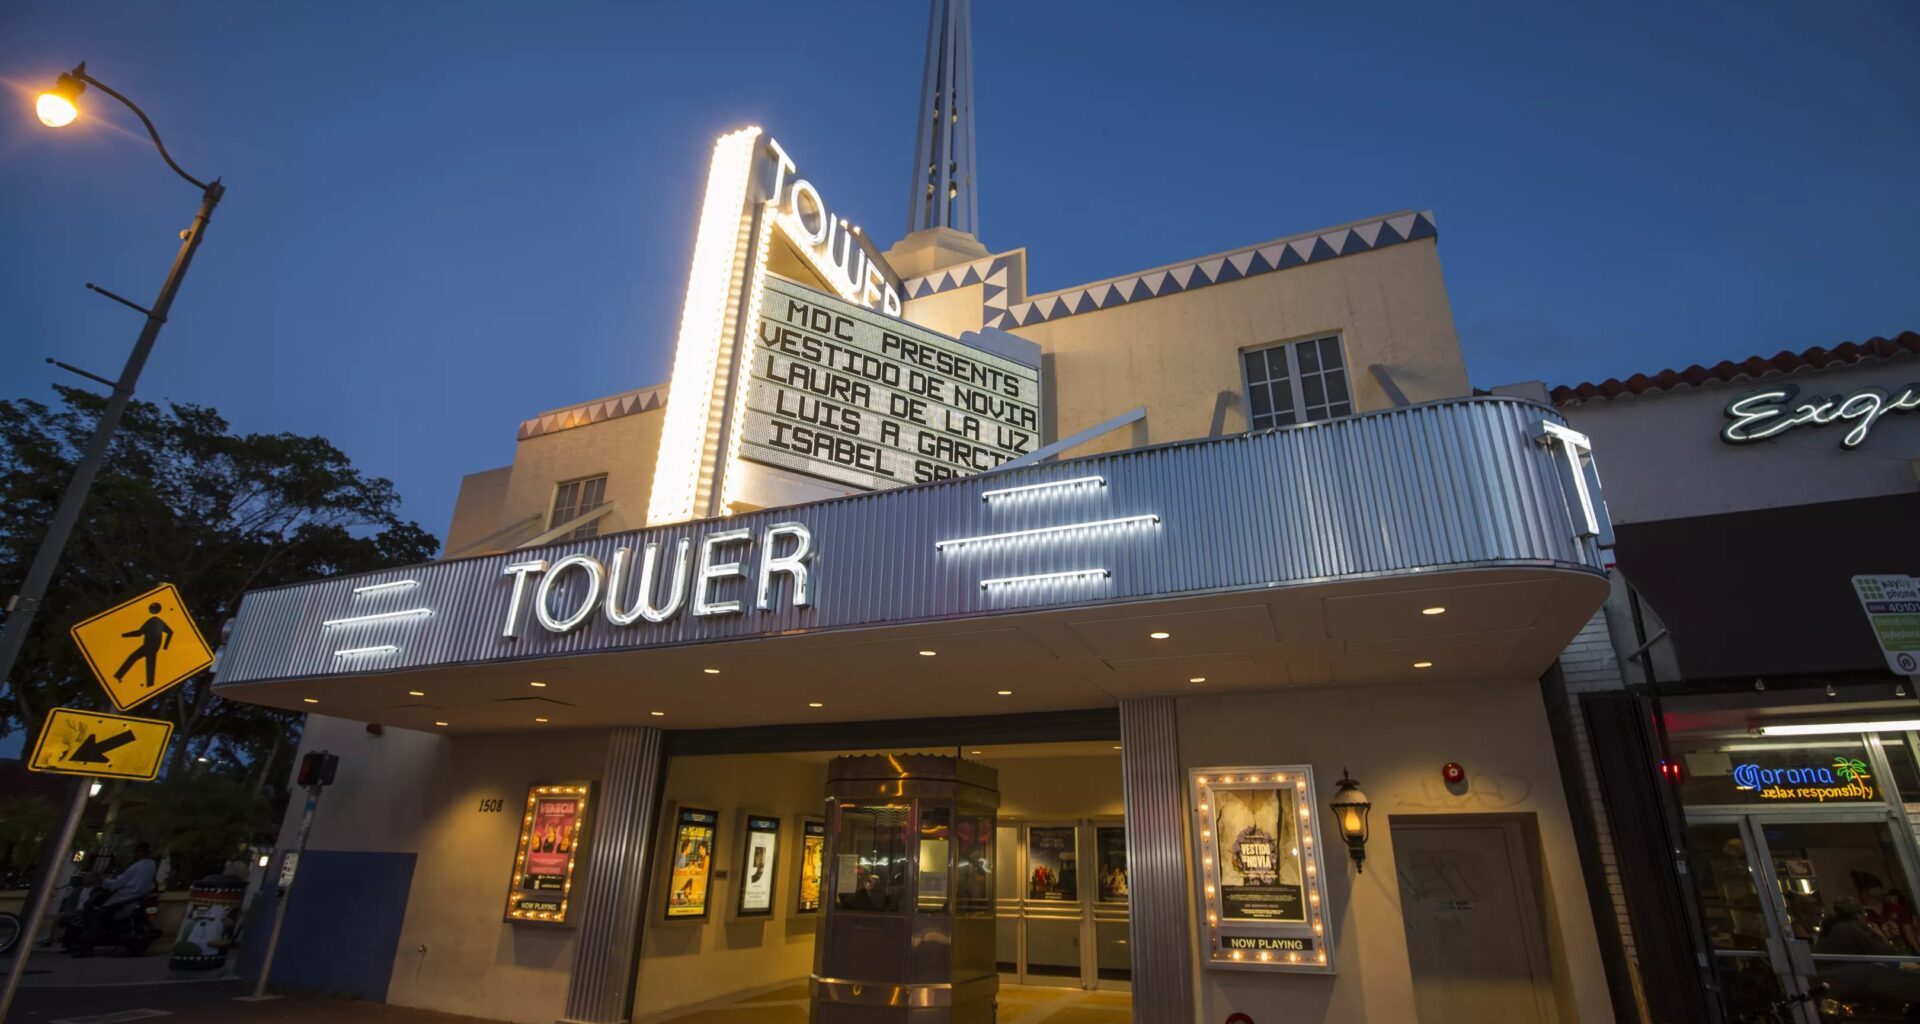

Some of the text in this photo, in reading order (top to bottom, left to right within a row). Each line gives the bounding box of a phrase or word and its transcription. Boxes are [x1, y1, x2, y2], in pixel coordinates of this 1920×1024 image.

[769, 137, 902, 317] TOWER
[787, 300, 1019, 397] MDC PRESENTS
[760, 322, 1037, 431] VESTIDO DE NOVIA
[766, 355, 1029, 454] LAURA DE LA UZ
[776, 390, 1016, 472] LUIS A GARCI
[769, 420, 895, 477] ISABEL
[503, 521, 811, 638] TOWER
[1886, 588, 1918, 600] phone
[1734, 764, 1835, 791] Corona
[479, 799, 504, 813] 1508
[1760, 783, 1873, 802] relax responsibly
[1241, 843, 1271, 855] VESTIDO
[1247, 856, 1273, 868] NOVIA
[521, 902, 557, 911] NOW PLAYING
[1231, 938, 1303, 950] NOW PLAYING
